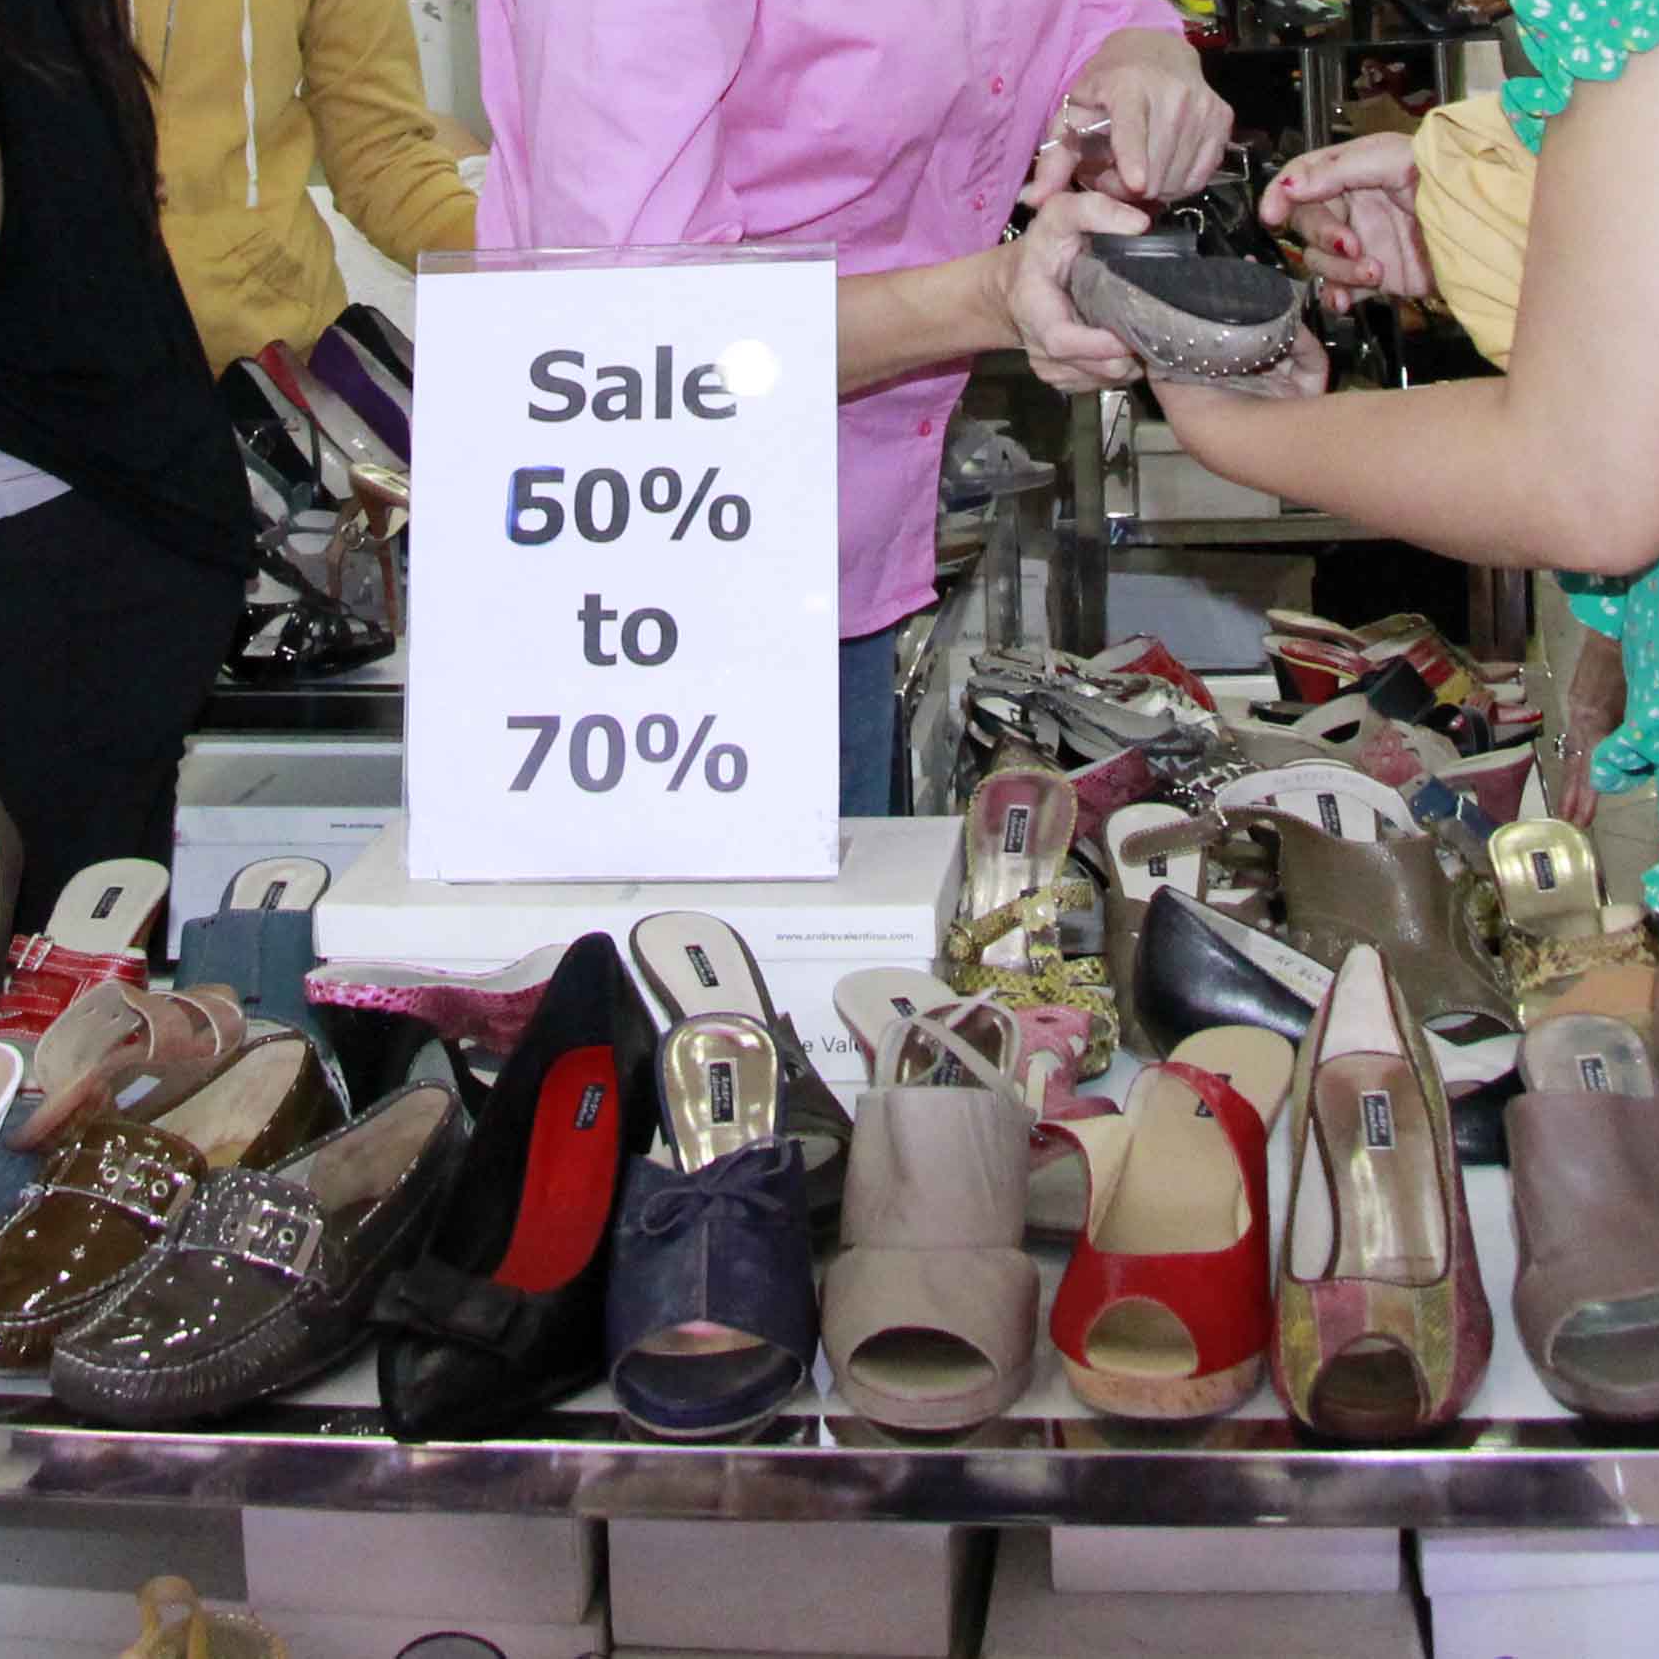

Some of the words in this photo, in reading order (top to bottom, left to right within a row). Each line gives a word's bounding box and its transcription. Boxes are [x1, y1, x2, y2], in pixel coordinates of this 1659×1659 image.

[528, 343, 739, 423] Sale
[577, 593, 678, 667] to
[506, 712, 749, 794] 70%
